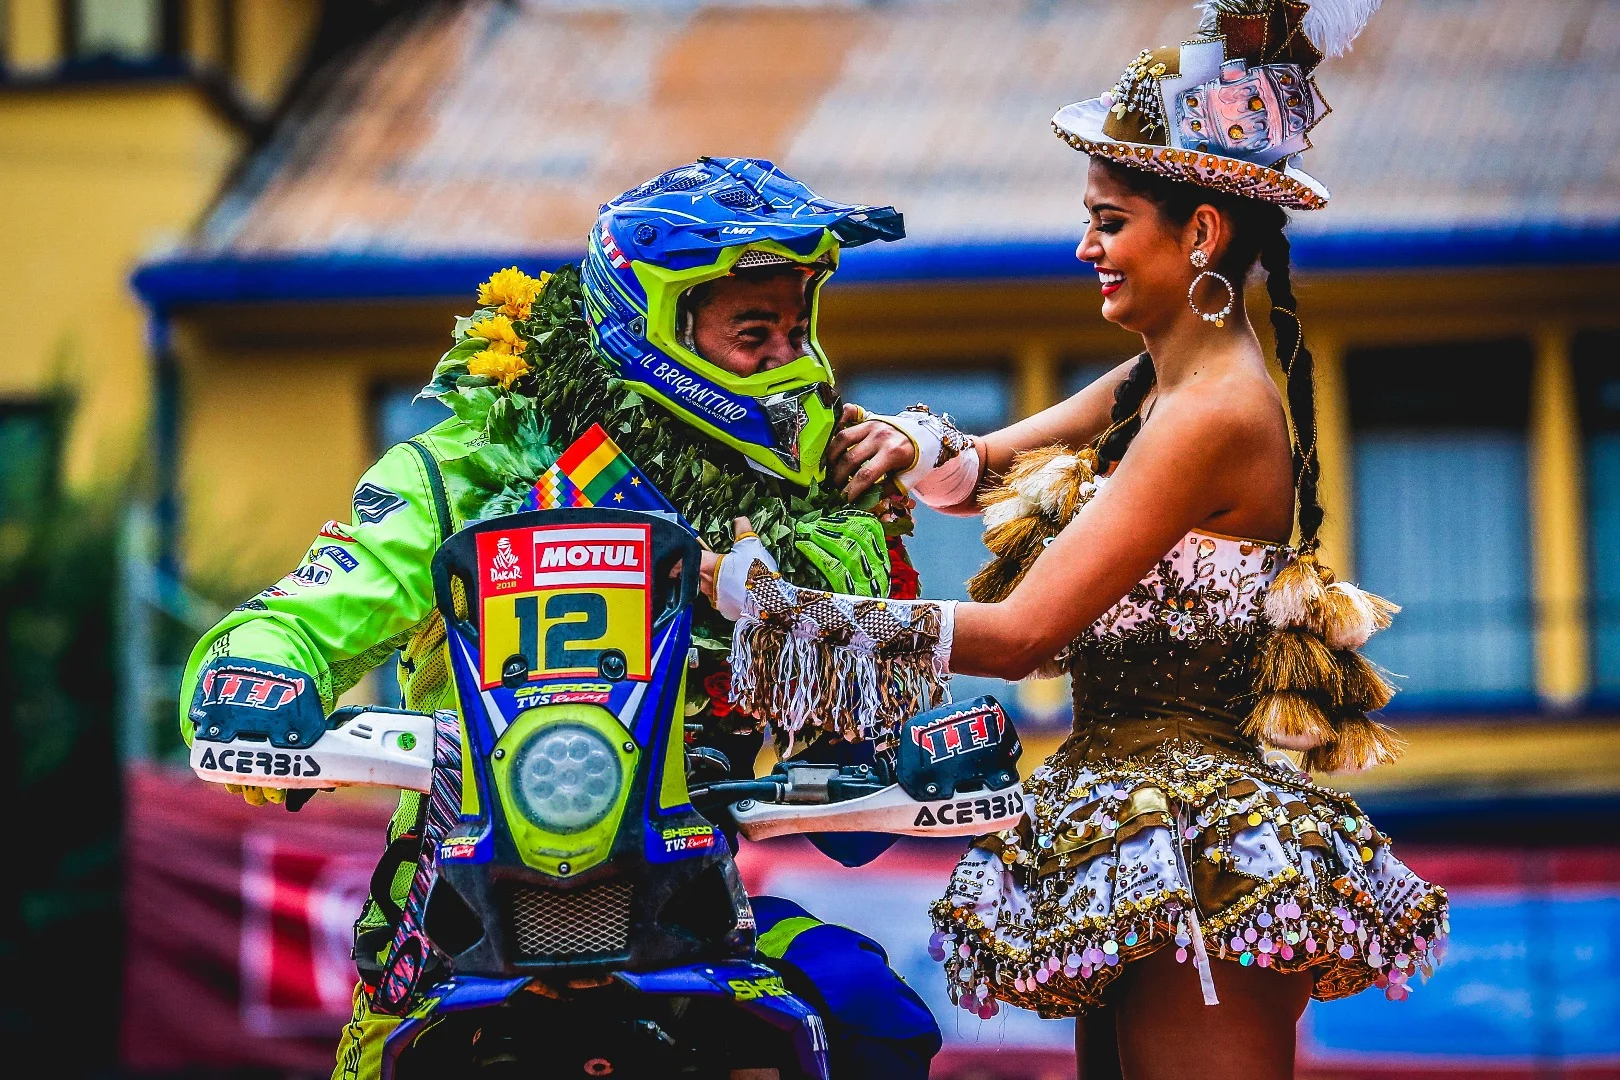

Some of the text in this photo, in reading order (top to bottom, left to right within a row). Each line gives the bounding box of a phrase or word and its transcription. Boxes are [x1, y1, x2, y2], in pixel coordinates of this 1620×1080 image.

[721, 226, 757, 235] LMR
[640, 353, 748, 421] IL BRIGANTINO
[540, 545, 639, 568] MOTUL
[490, 567, 522, 582] DAKAR
[496, 580, 517, 590] 2018
[514, 592, 608, 671] 12
[513, 683, 614, 698] SHERCO
[517, 692, 610, 709] TVS Racing
[663, 826, 713, 840] SHERCO
[664, 837, 687, 852] TVS
